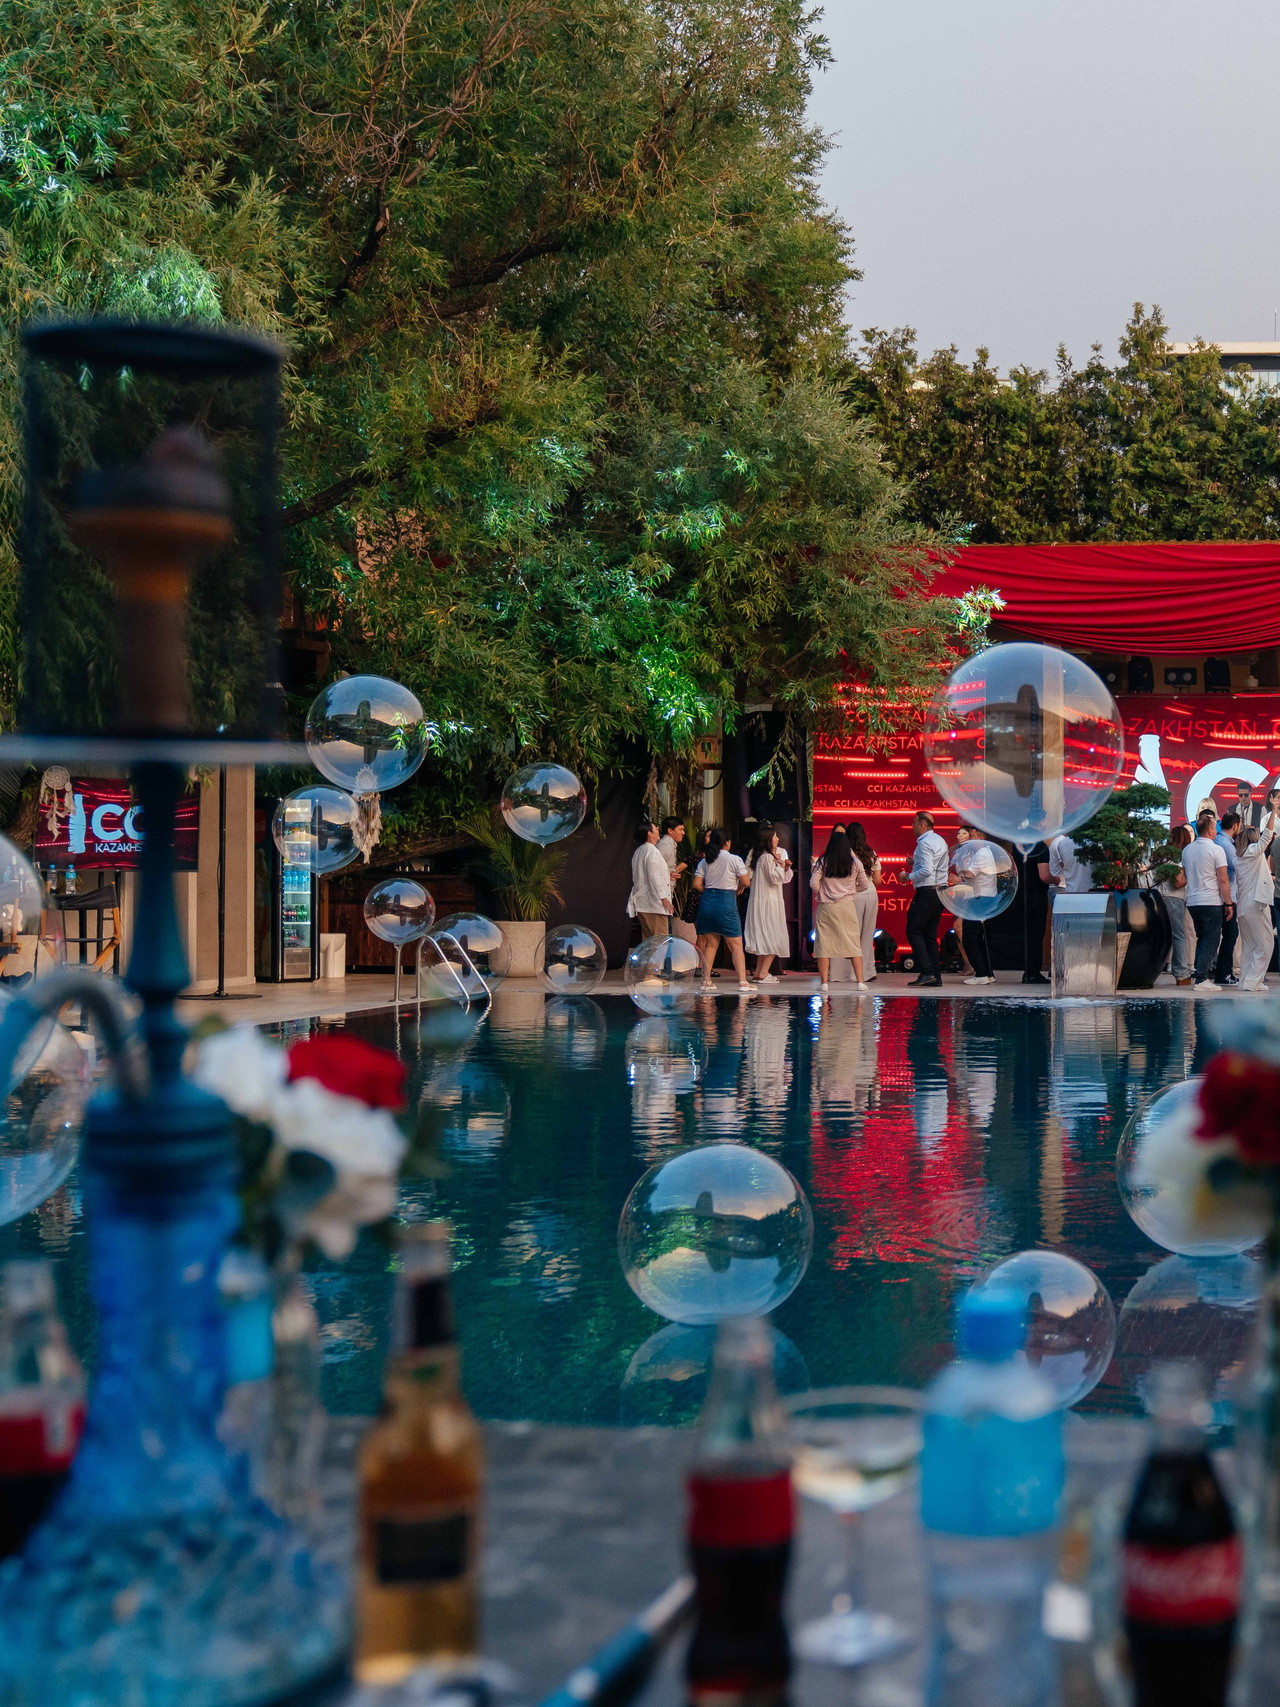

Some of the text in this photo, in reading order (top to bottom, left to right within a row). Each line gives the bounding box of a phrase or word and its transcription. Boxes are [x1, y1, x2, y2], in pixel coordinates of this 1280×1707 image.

[867, 784, 883, 793] CCI
[834, 799, 917, 808] CCI KAZAKHSTAN
[91, 803, 147, 841] CC
[95, 842, 143, 853] KAZAKHS
